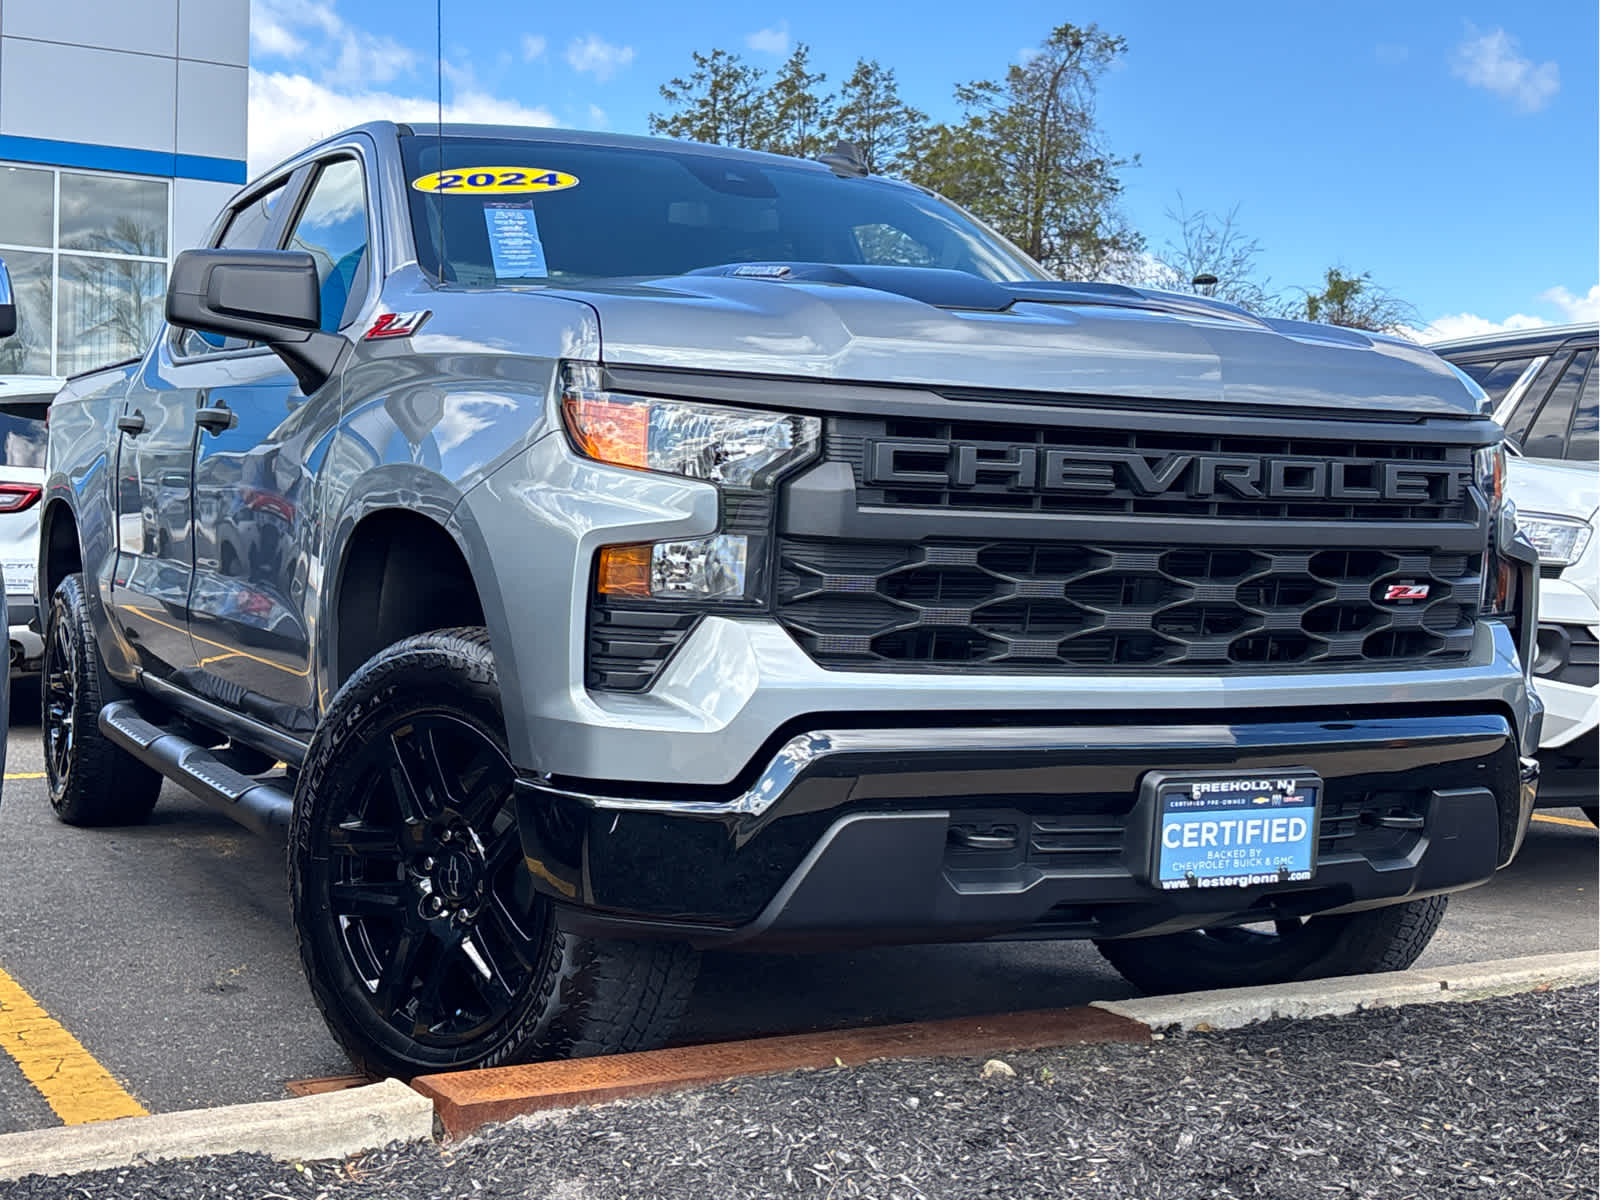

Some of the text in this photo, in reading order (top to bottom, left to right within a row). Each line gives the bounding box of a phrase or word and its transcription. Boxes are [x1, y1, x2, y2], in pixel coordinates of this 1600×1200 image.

[433, 172, 561, 189] 2024
[866, 440, 1473, 500] CHEVROLET
[1192, 780, 1273, 794] FREEHOLD,
[1169, 800, 1205, 808] CERTIFIED
[1162, 817, 1307, 849] CERTIFIED
[1207, 848, 1263, 859] BACKED BY
[1172, 855, 1295, 871] CHEVROLET BUICK & GMC
